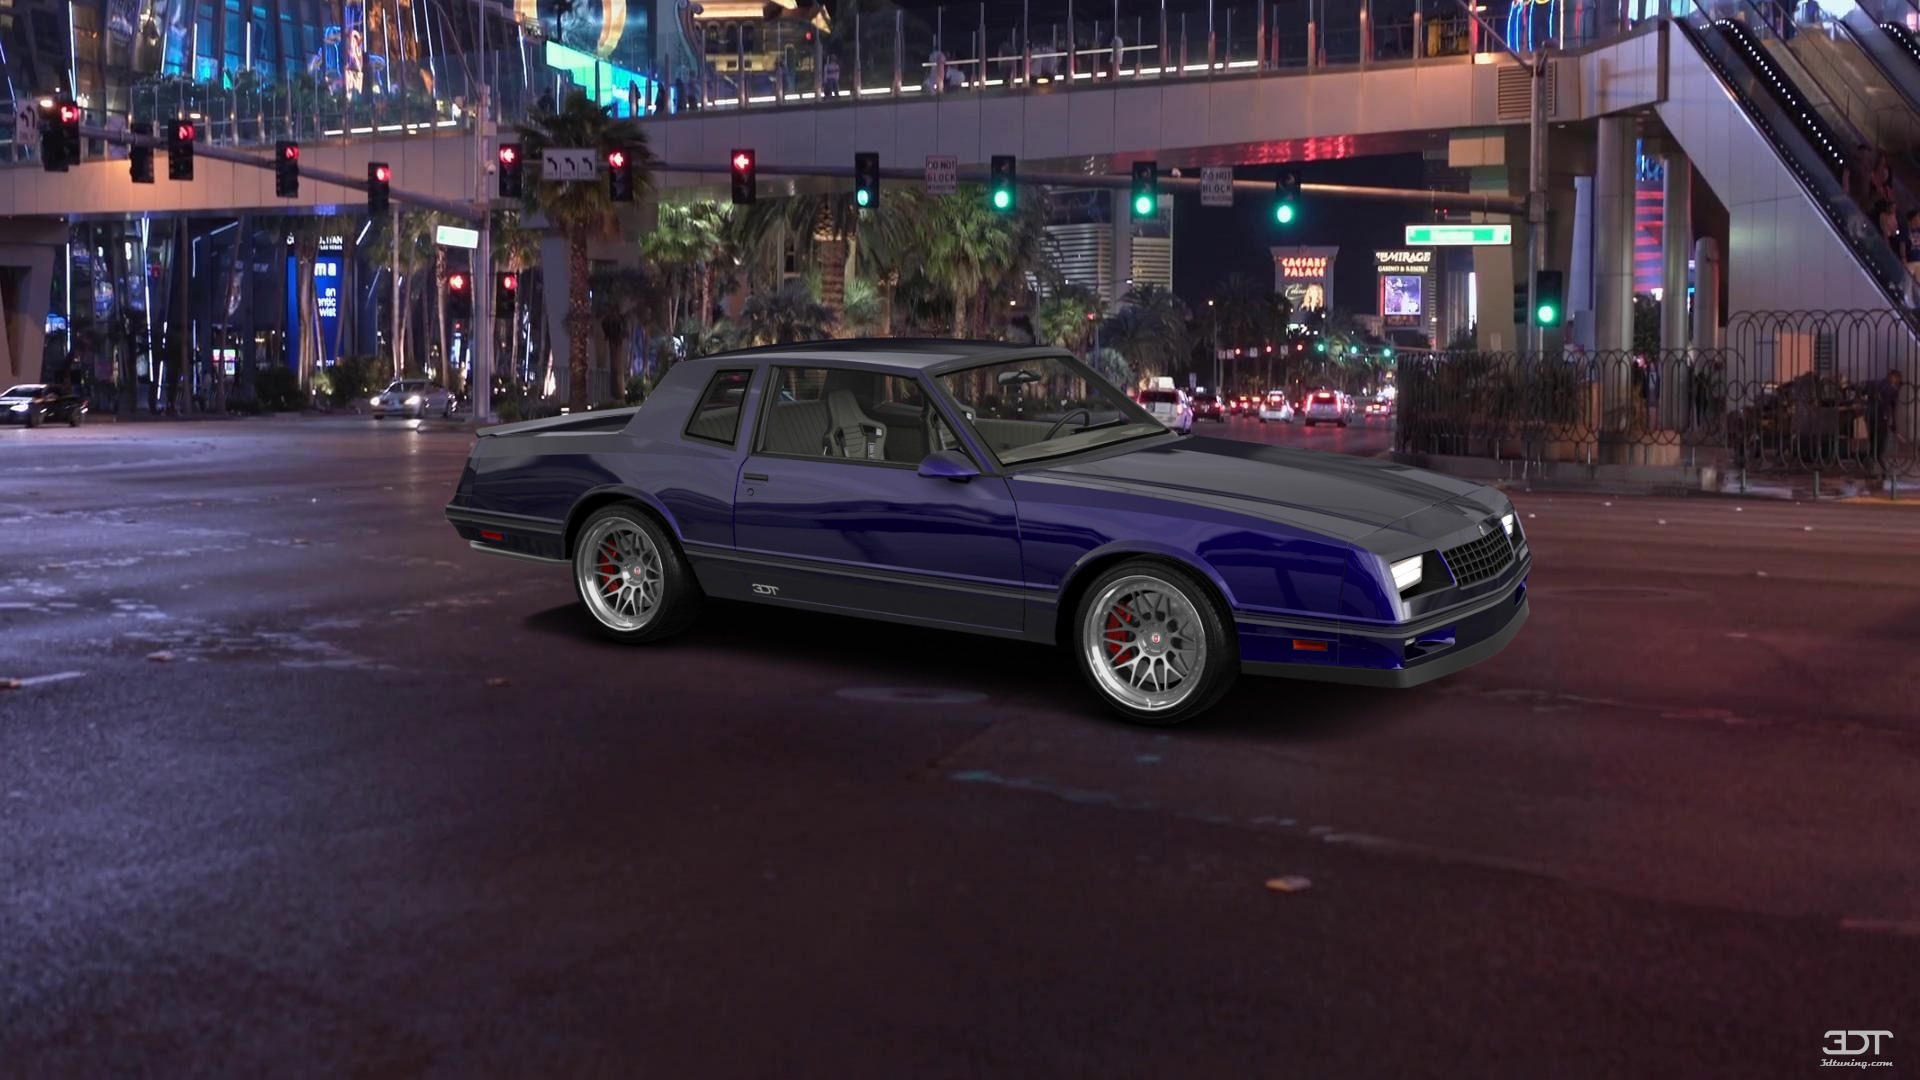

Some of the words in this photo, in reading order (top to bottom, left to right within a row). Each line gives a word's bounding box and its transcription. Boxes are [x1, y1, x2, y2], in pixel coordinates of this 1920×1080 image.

[1202, 183, 1231, 192] BLOCK
[1281, 257, 1327, 267] CAESARS
[1387, 252, 1431, 263] MIRAGE
[1284, 267, 1324, 277] PALACE
[752, 583, 779, 595] 3DT
